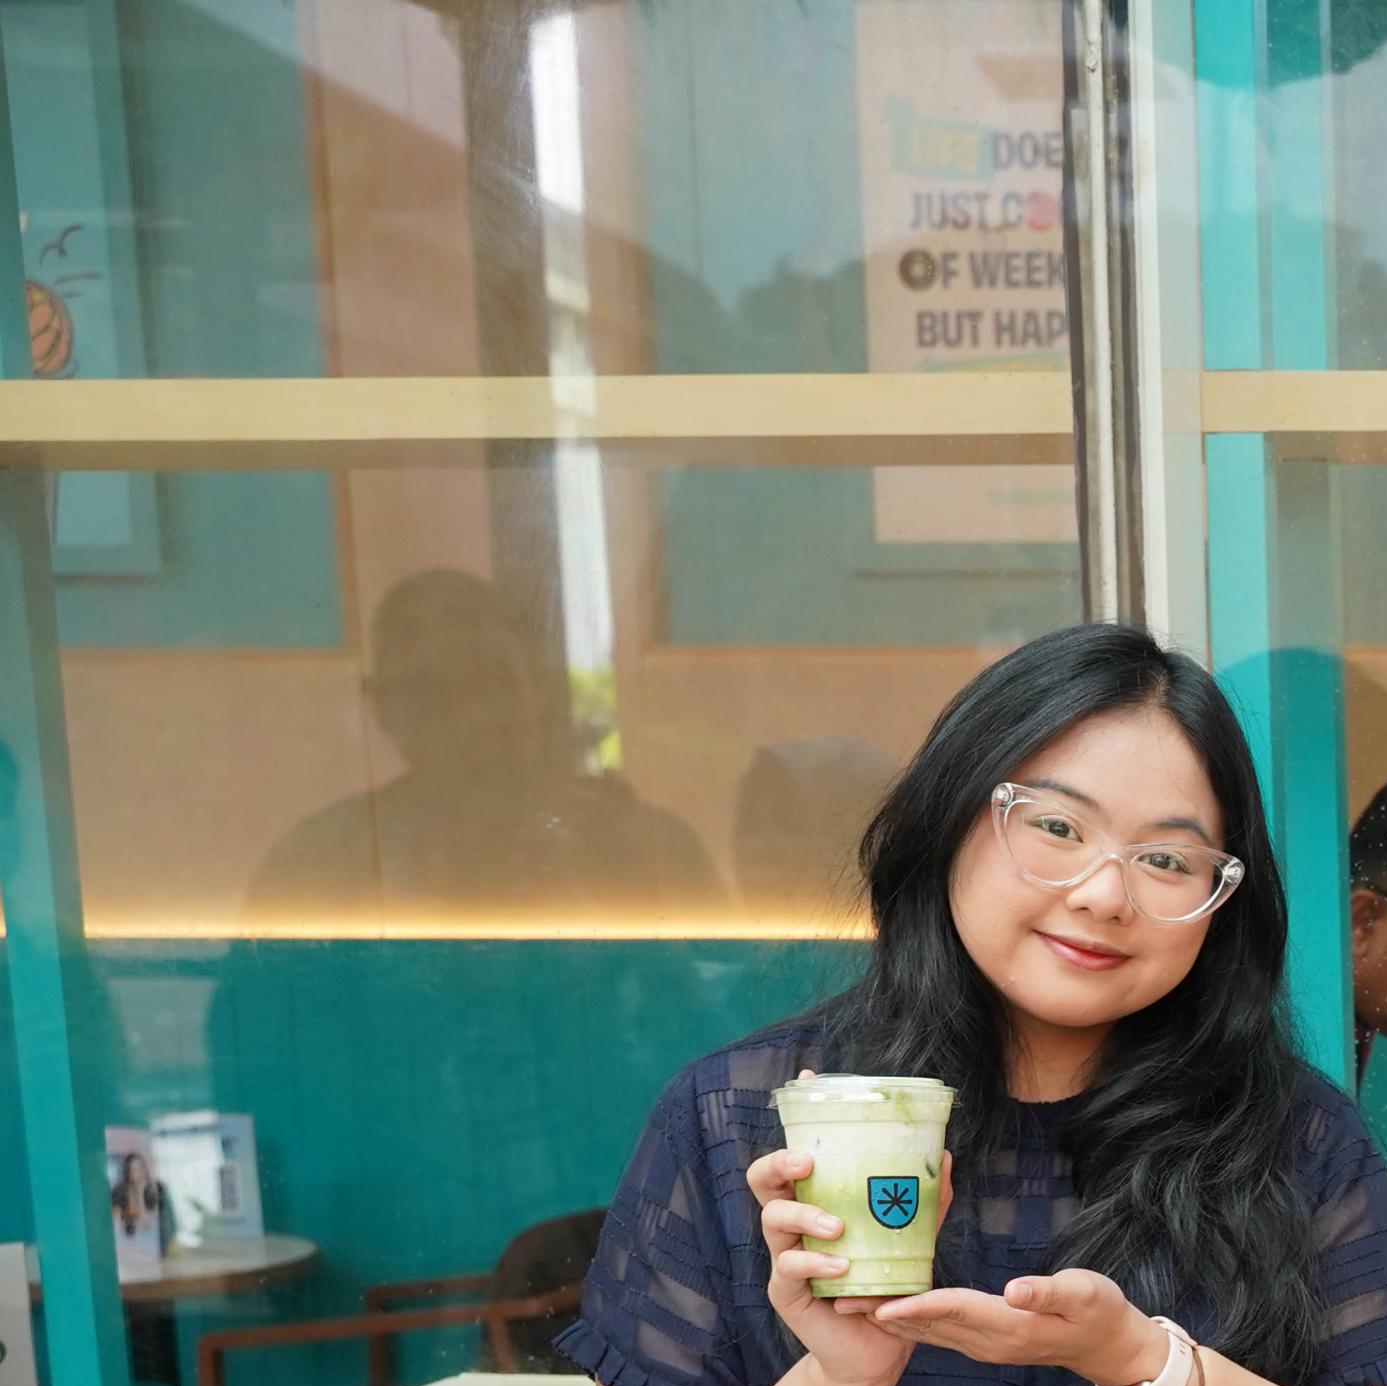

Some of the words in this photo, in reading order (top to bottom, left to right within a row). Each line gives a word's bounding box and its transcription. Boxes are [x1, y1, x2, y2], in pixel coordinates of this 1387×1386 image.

[910, 191, 988, 230] JUST
[897, 248, 959, 291] OF
[915, 309, 983, 348] BUT
